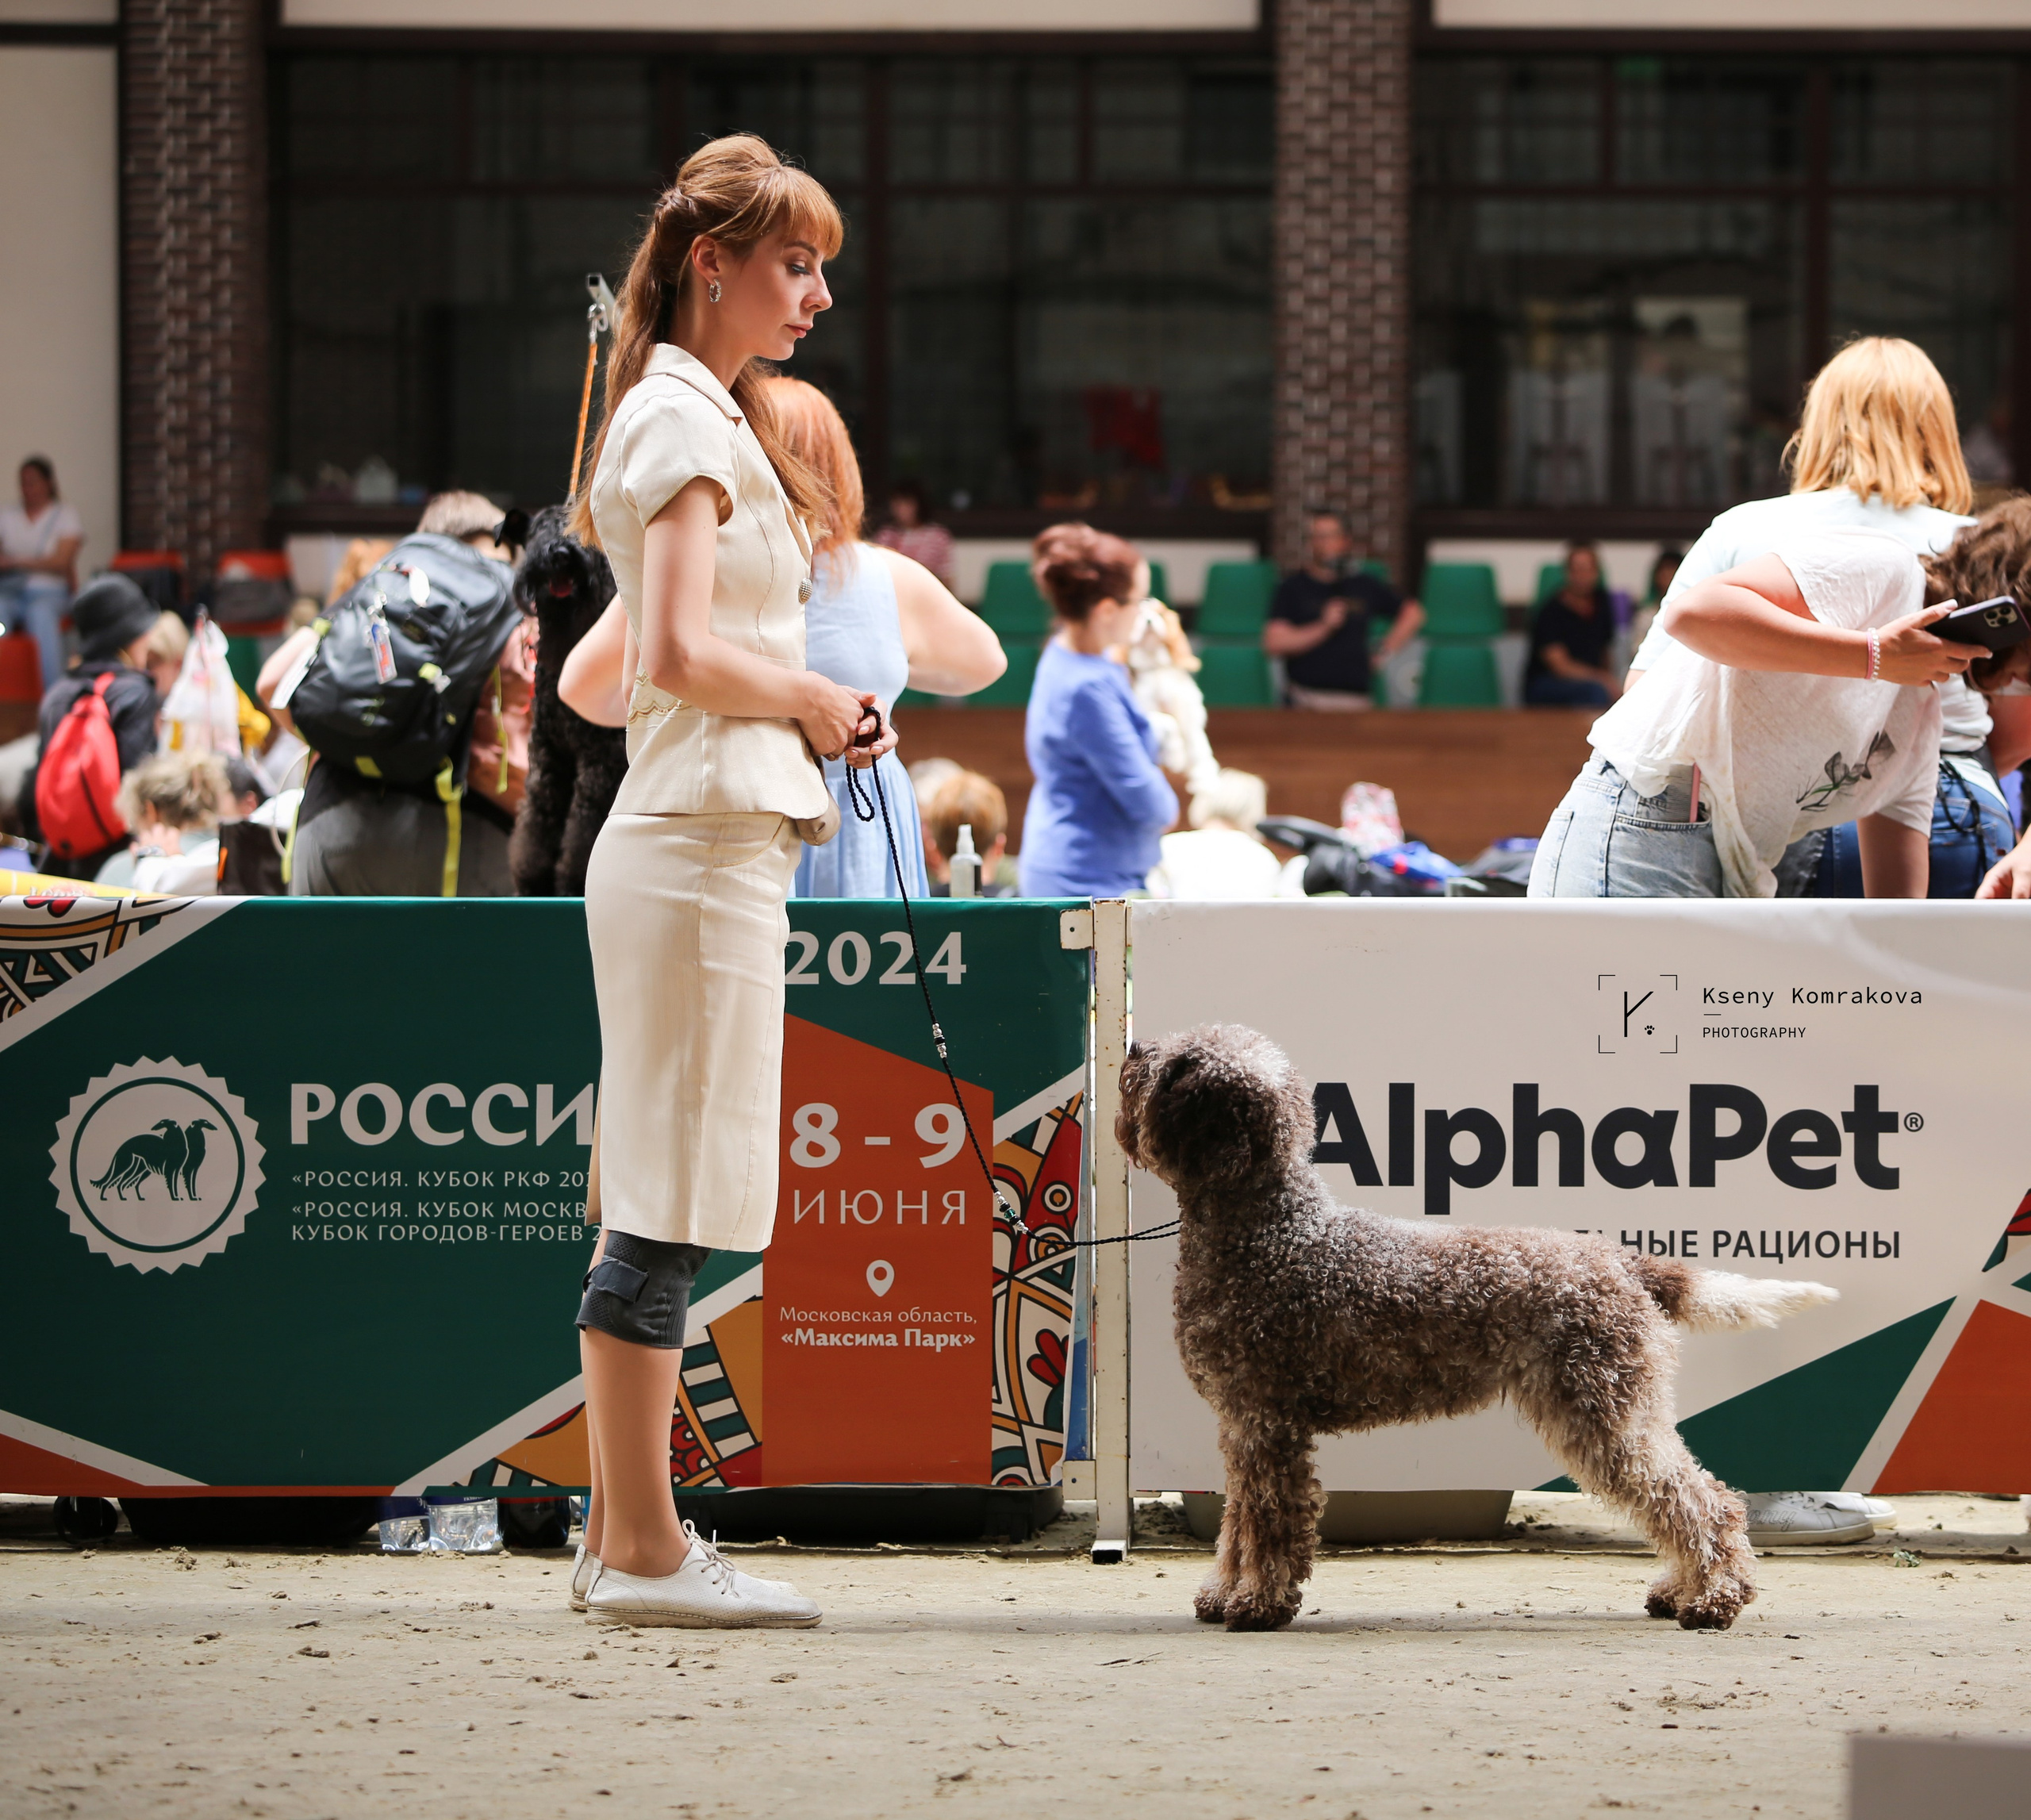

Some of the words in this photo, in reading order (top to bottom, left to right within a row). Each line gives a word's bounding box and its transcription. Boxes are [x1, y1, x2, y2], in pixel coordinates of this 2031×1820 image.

[785, 931, 967, 985] 2024
[290, 1082, 594, 1146] РОССИ
[789, 1102, 841, 1169] 8
[914, 1103, 966, 1169] 9
[292, 1170, 408, 1187] «РОССИЯ.
[418, 1170, 494, 1187] КУБОК
[505, 1170, 551, 1187] РКФ
[292, 1201, 408, 1218] «РОССИЯ.
[418, 1201, 494, 1218] КУБОК
[504, 1201, 586, 1218] МОСКВ
[794, 1189, 966, 1225] ИЮНЯ
[293, 1224, 369, 1241] КУБОК
[378, 1224, 583, 1244] ГОРОДОВ-ГЕРОЕВ
[1713, 1230, 1900, 1265] РАЦИОНЫ
[780, 1306, 893, 1323] Московская
[897, 1306, 977, 1324] область,
[781, 1327, 899, 1347] «Максима
[904, 1328, 976, 1353] Парк»
